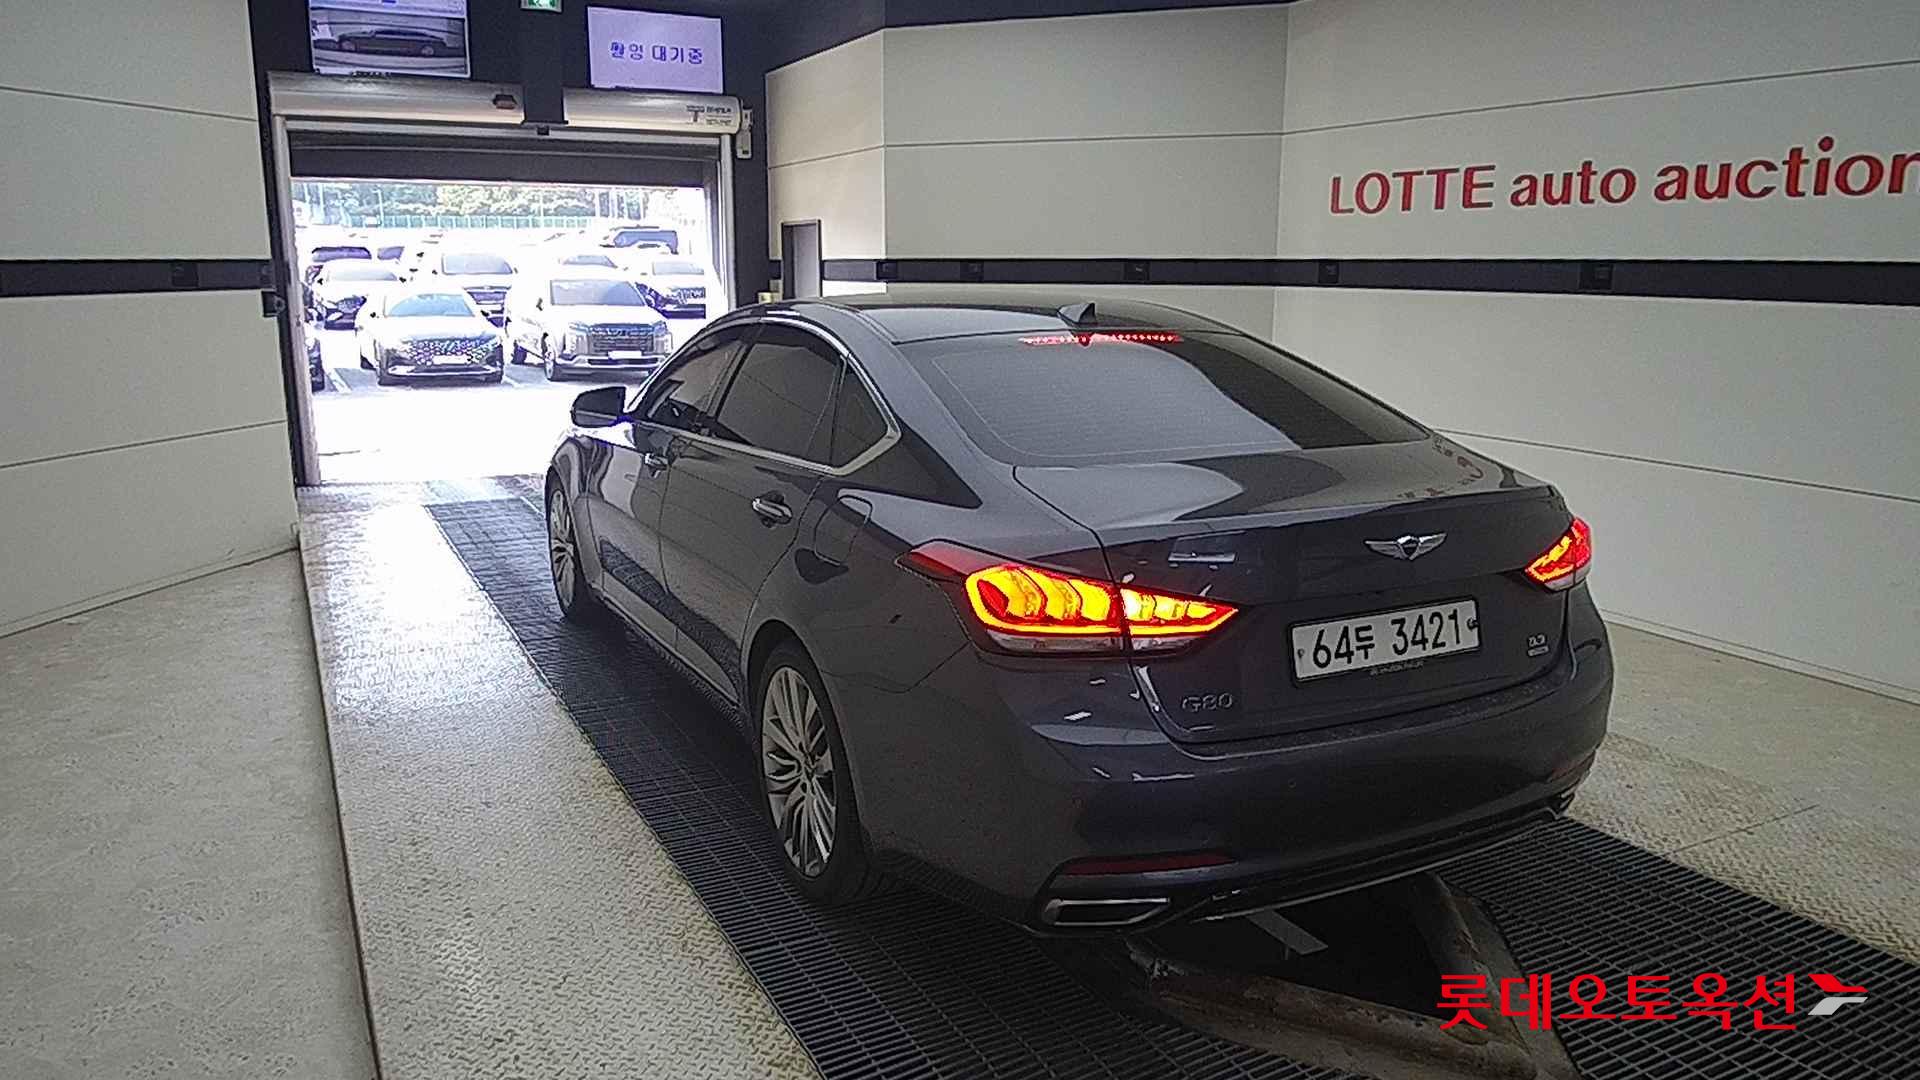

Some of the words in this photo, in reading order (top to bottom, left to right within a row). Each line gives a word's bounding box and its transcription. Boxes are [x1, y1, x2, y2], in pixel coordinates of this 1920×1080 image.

[652, 45, 702, 64] 대기중
[1331, 164, 1497, 214] LOTTE
[1510, 160, 1637, 207] auto
[1313, 624, 1375, 669] 64두
[1390, 608, 1460, 656] 3421
[1182, 692, 1233, 712] G80
